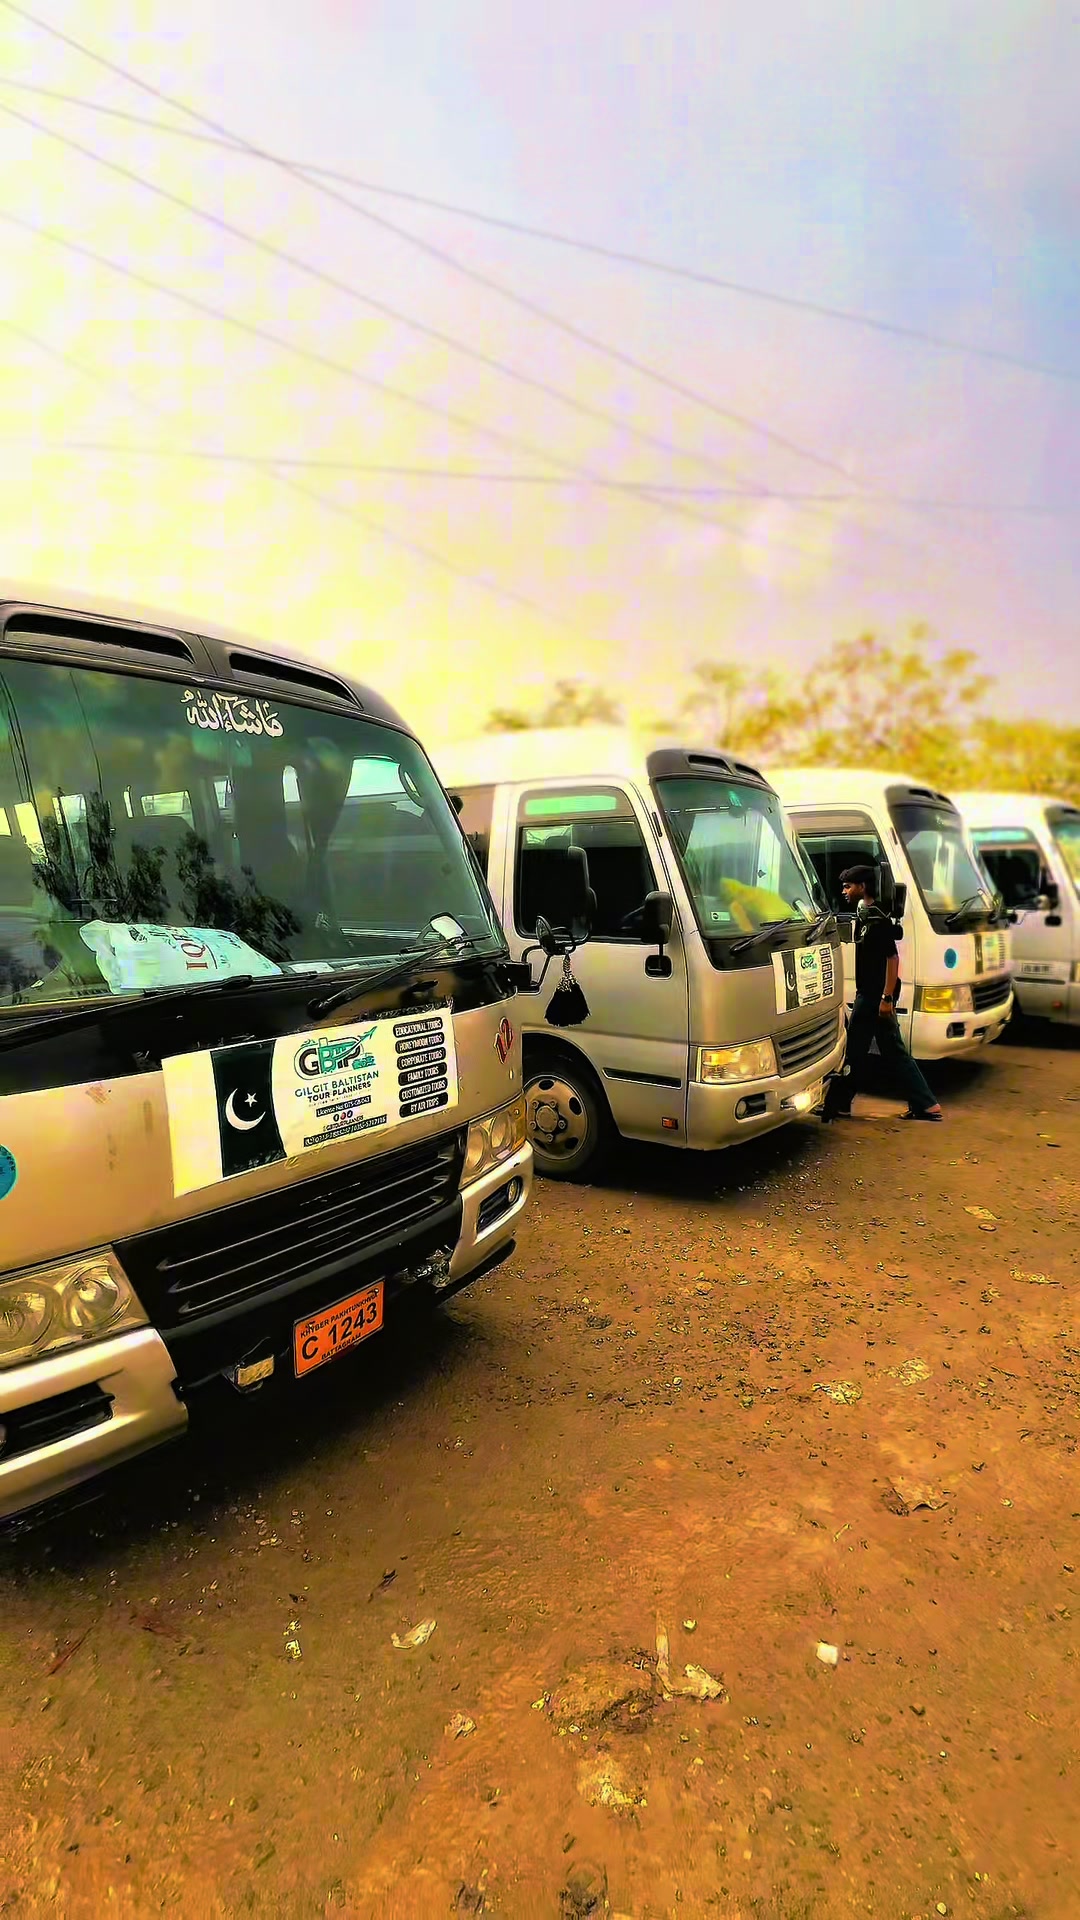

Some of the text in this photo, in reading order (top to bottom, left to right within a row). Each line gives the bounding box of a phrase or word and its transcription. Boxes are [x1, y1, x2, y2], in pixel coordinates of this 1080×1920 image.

[395, 1020, 441, 1036] EDUCATIONAL TOURS
[400, 1034, 442, 1051] HONEYMOON TOURS
[401, 1050, 442, 1067] CORPORATE TOURS
[407, 1066, 439, 1082] FAMILY TOURS
[294, 1070, 379, 1097] GILGIT BALTISTAN
[307, 1092, 330, 1103] TOUR
[332, 1081, 371, 1097] PLANNERS
[431, 1080, 446, 1091] TOURS
[410, 1103, 417, 1113] BY
[417, 1101, 426, 1111] AIR
[300, 1319, 330, 1338] KHYBER
[301, 1302, 377, 1360] C 1243
